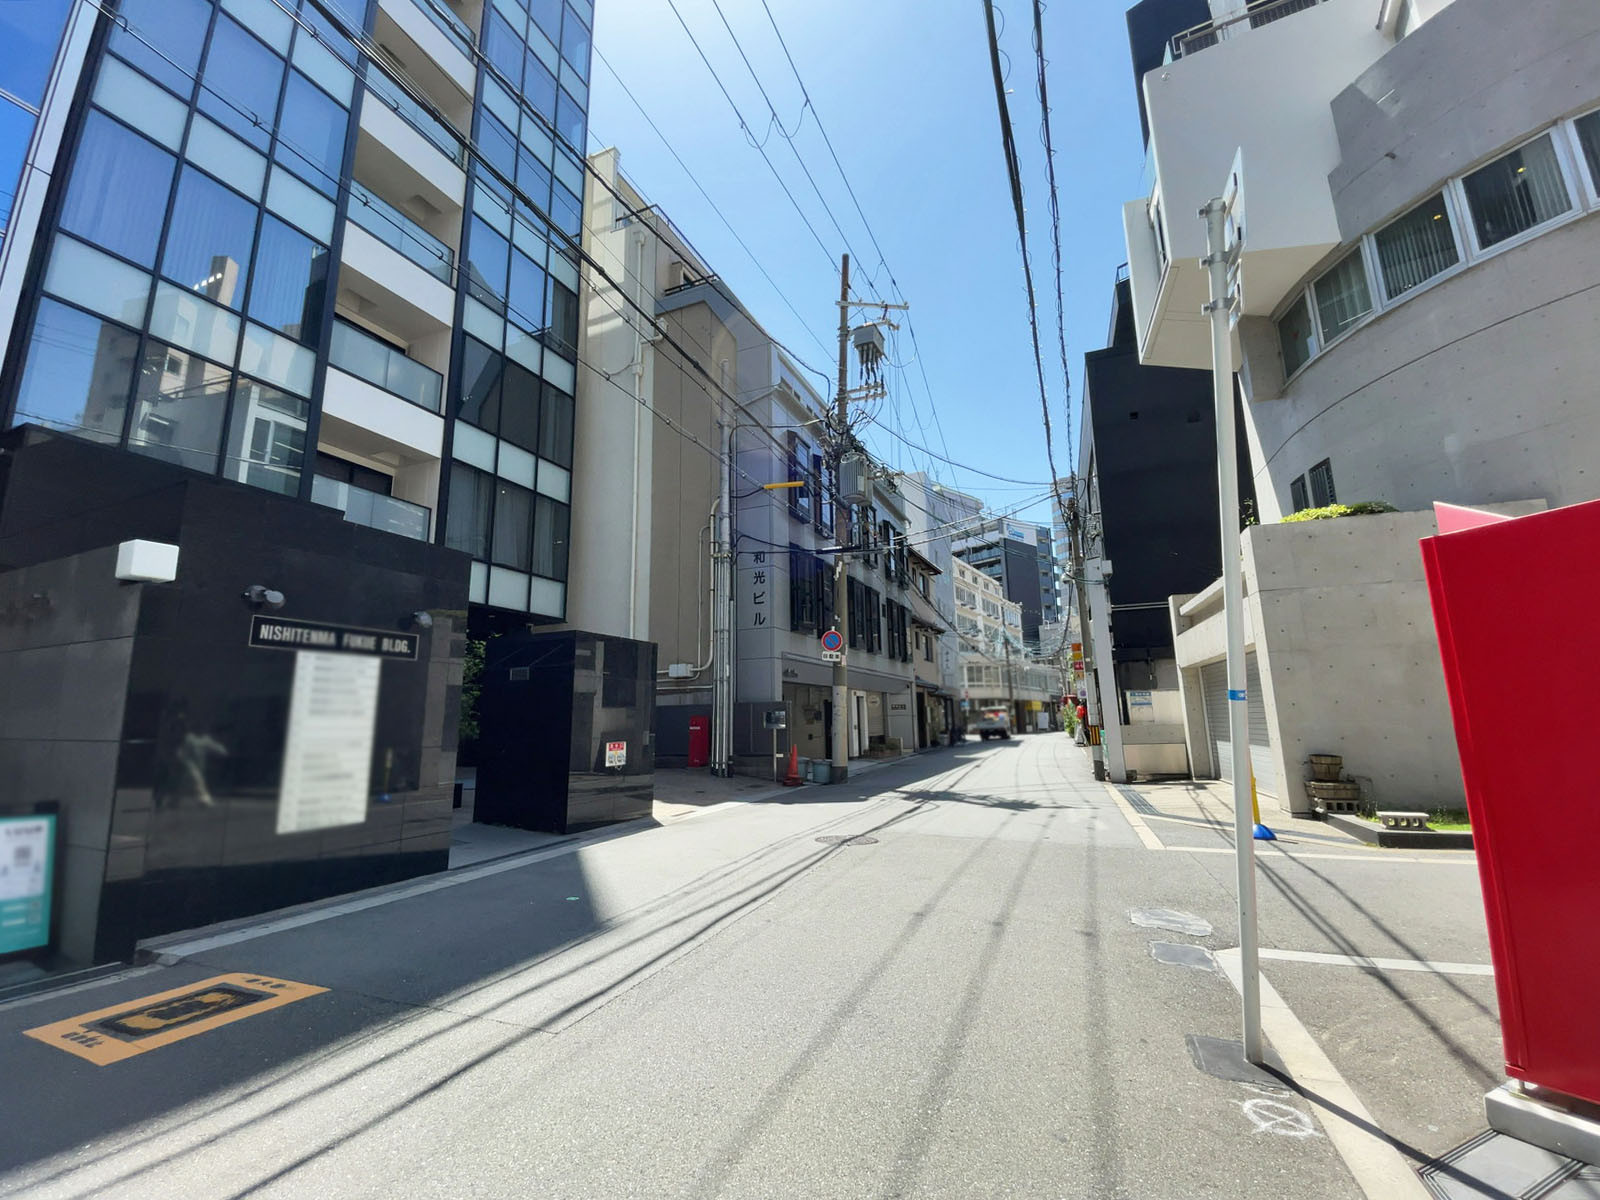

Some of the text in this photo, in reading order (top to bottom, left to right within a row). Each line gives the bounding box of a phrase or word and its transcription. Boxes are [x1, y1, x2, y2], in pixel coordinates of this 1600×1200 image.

[753, 550, 766, 626] 和光ビル
[260, 624, 336, 647] NISHITENMA
[381, 637, 412, 654] BLDG.
